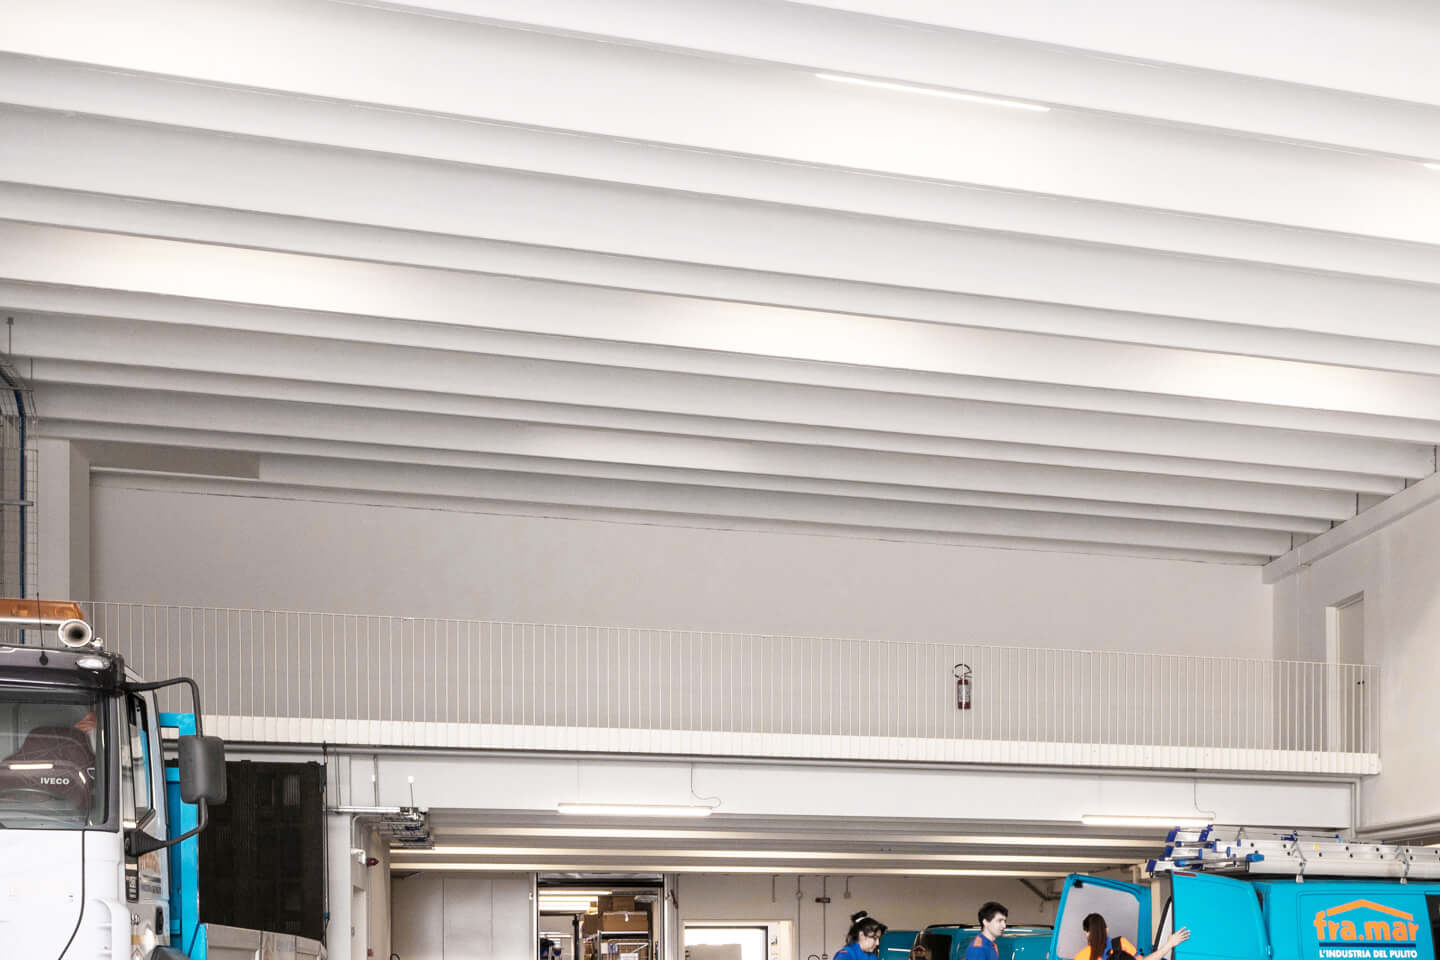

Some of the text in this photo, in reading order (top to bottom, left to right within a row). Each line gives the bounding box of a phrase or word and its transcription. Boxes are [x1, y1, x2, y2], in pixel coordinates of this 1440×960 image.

[40, 777, 70, 785] IVECO
[1313, 910, 1419, 941] fra.mar
[1373, 949, 1388, 959] DEL
[1389, 949, 1418, 959] PULITO
